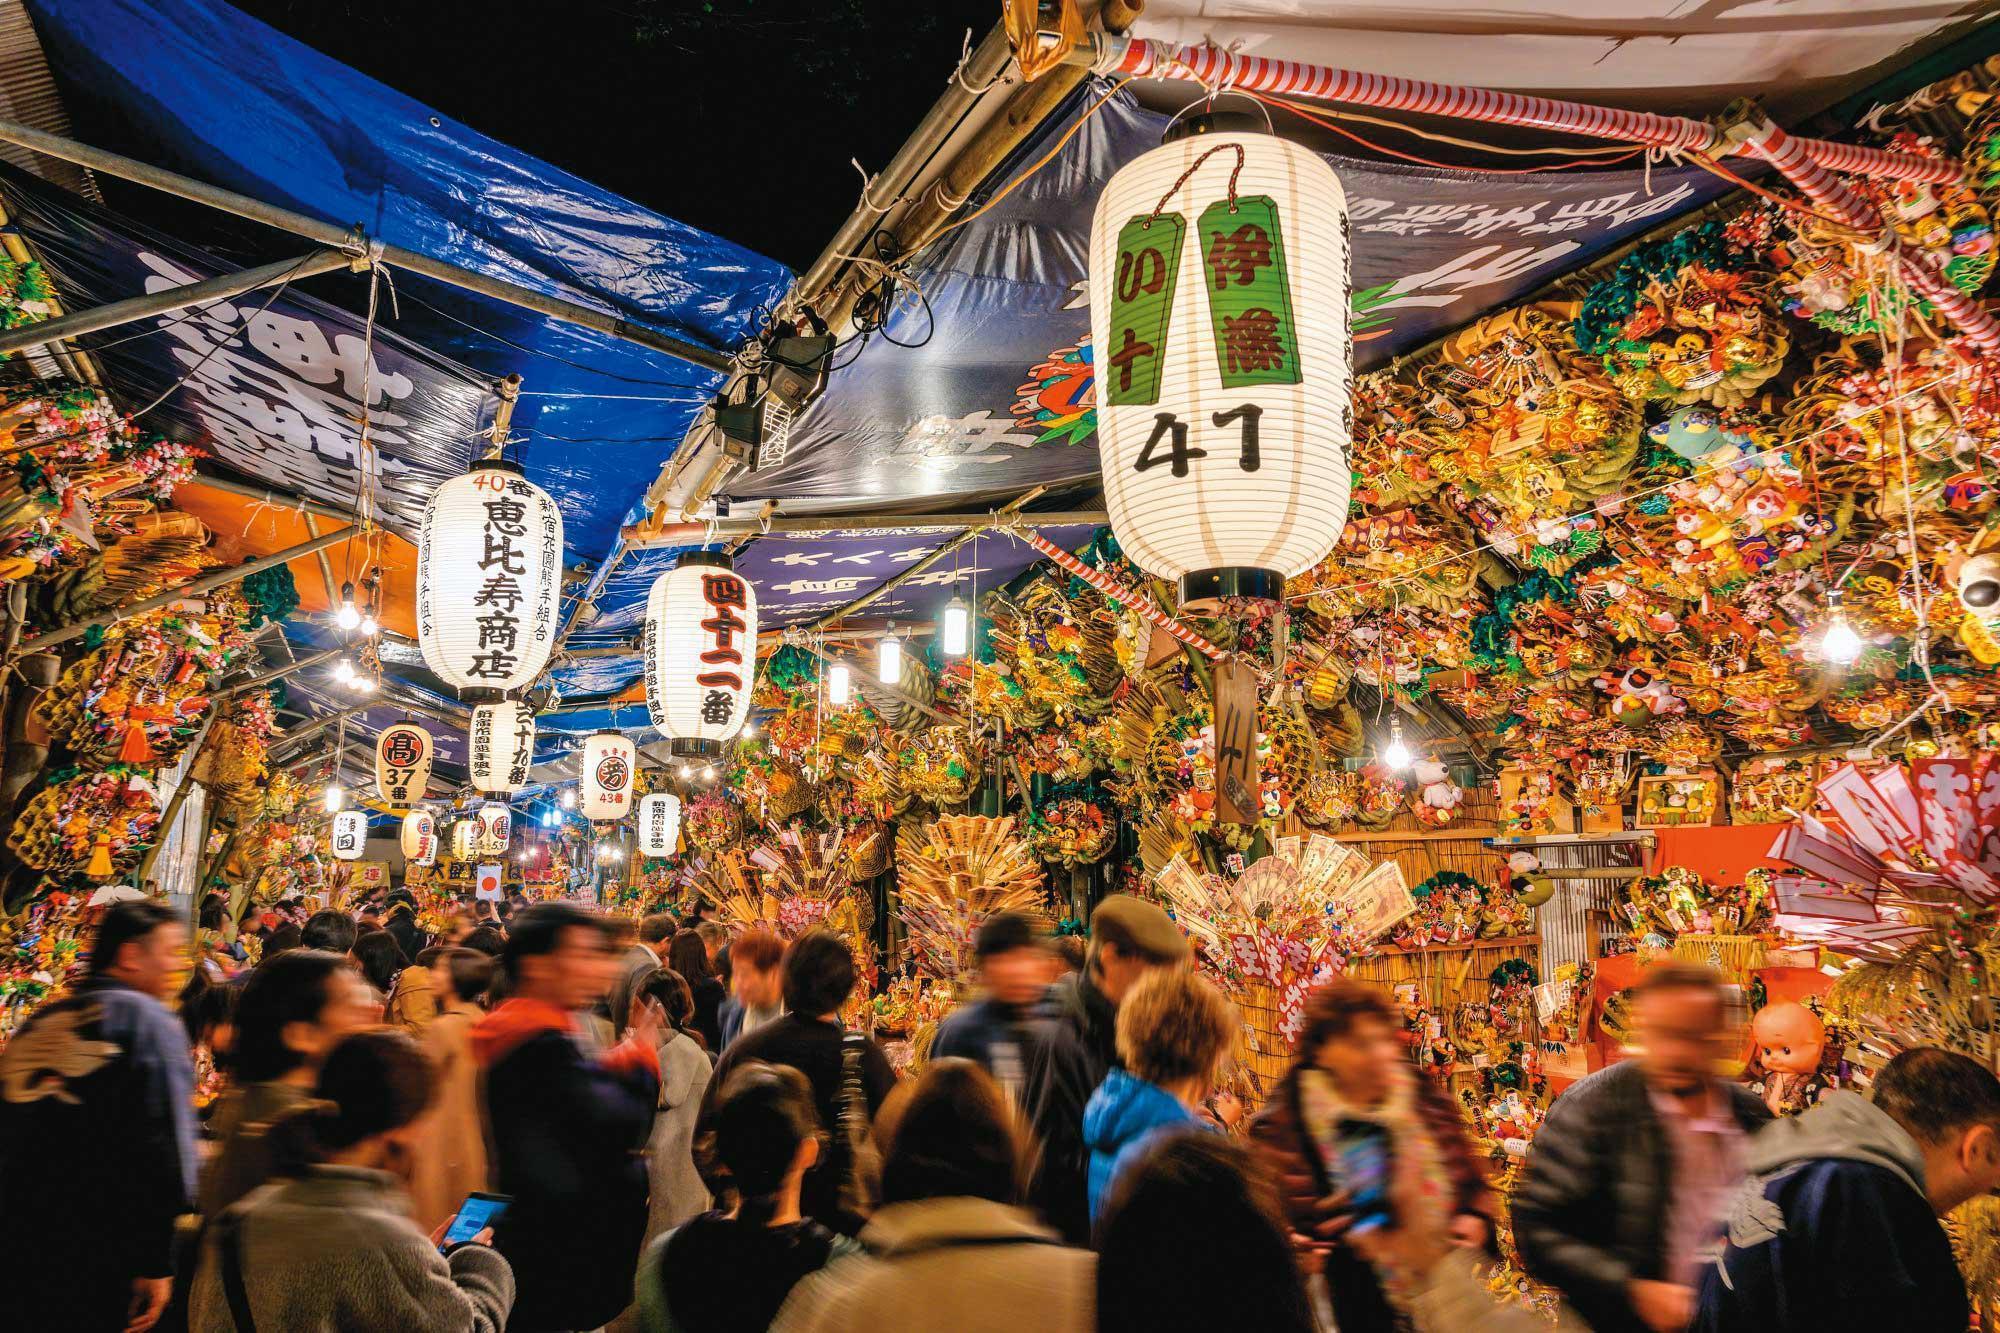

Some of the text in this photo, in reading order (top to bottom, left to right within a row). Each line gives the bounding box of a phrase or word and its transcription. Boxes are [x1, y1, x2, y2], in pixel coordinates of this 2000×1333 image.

[1207, 222, 1286, 375] 伊藤
[472, 474, 535, 498] 40番
[465, 495, 528, 680] 恵比寿商店
[696, 574, 748, 726] 四十二番
[385, 768, 416, 786] 37
[391, 786, 408, 800] 番
